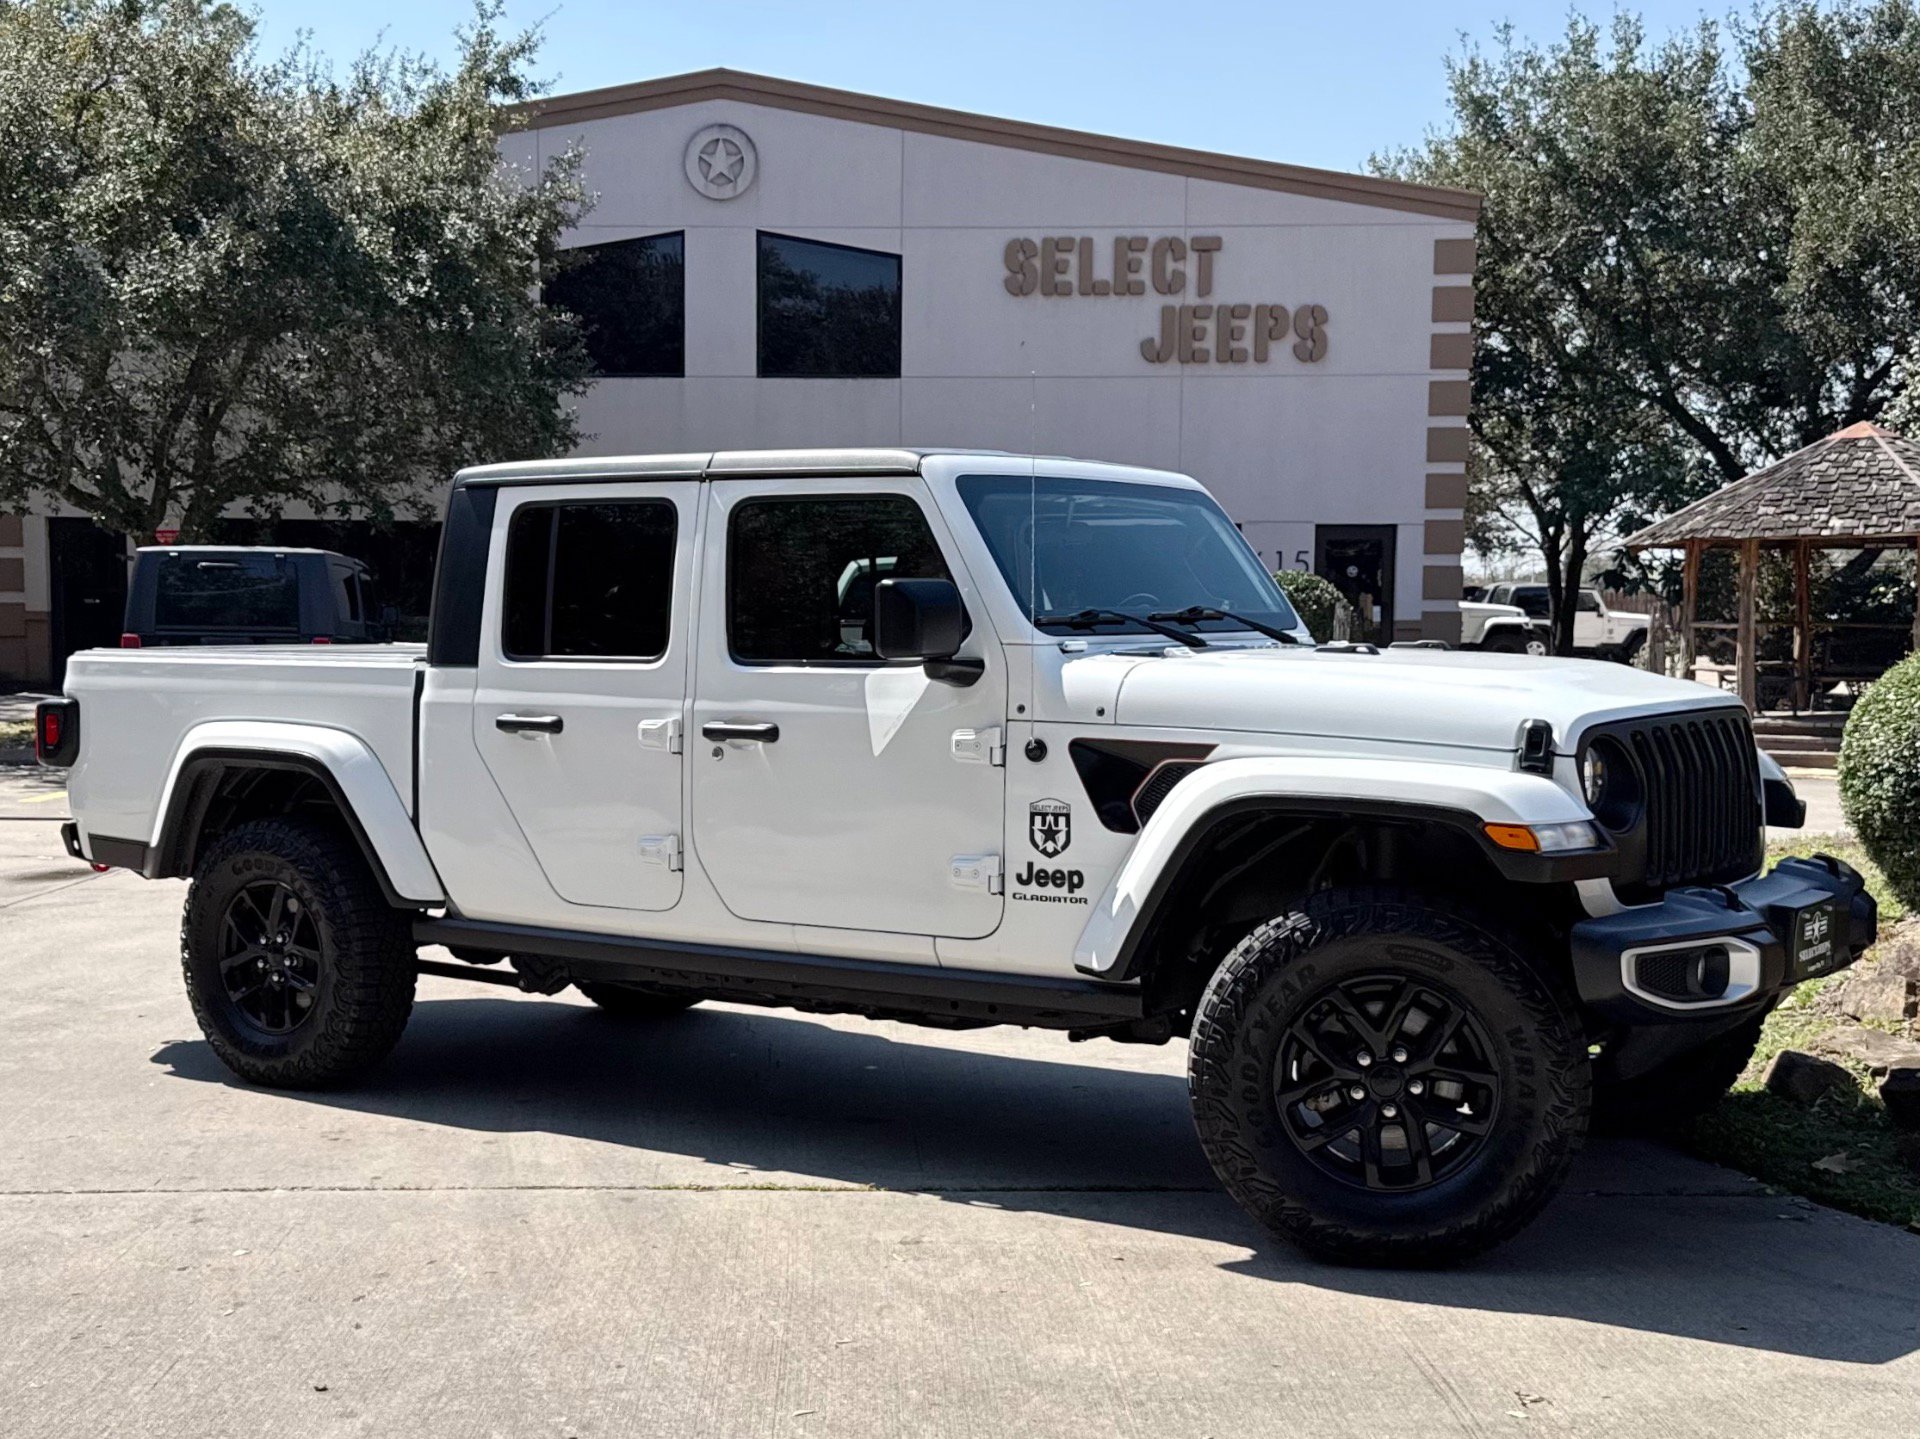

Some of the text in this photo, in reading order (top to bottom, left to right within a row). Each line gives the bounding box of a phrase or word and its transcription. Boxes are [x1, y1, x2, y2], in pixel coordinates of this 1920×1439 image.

[1004, 236, 1222, 297] SELECT
[1140, 304, 1328, 363] JEEPS
[1258, 551, 1309, 572] 15
[1016, 861, 1084, 894] Jeep
[1012, 892, 1088, 905] GLADIATOR
